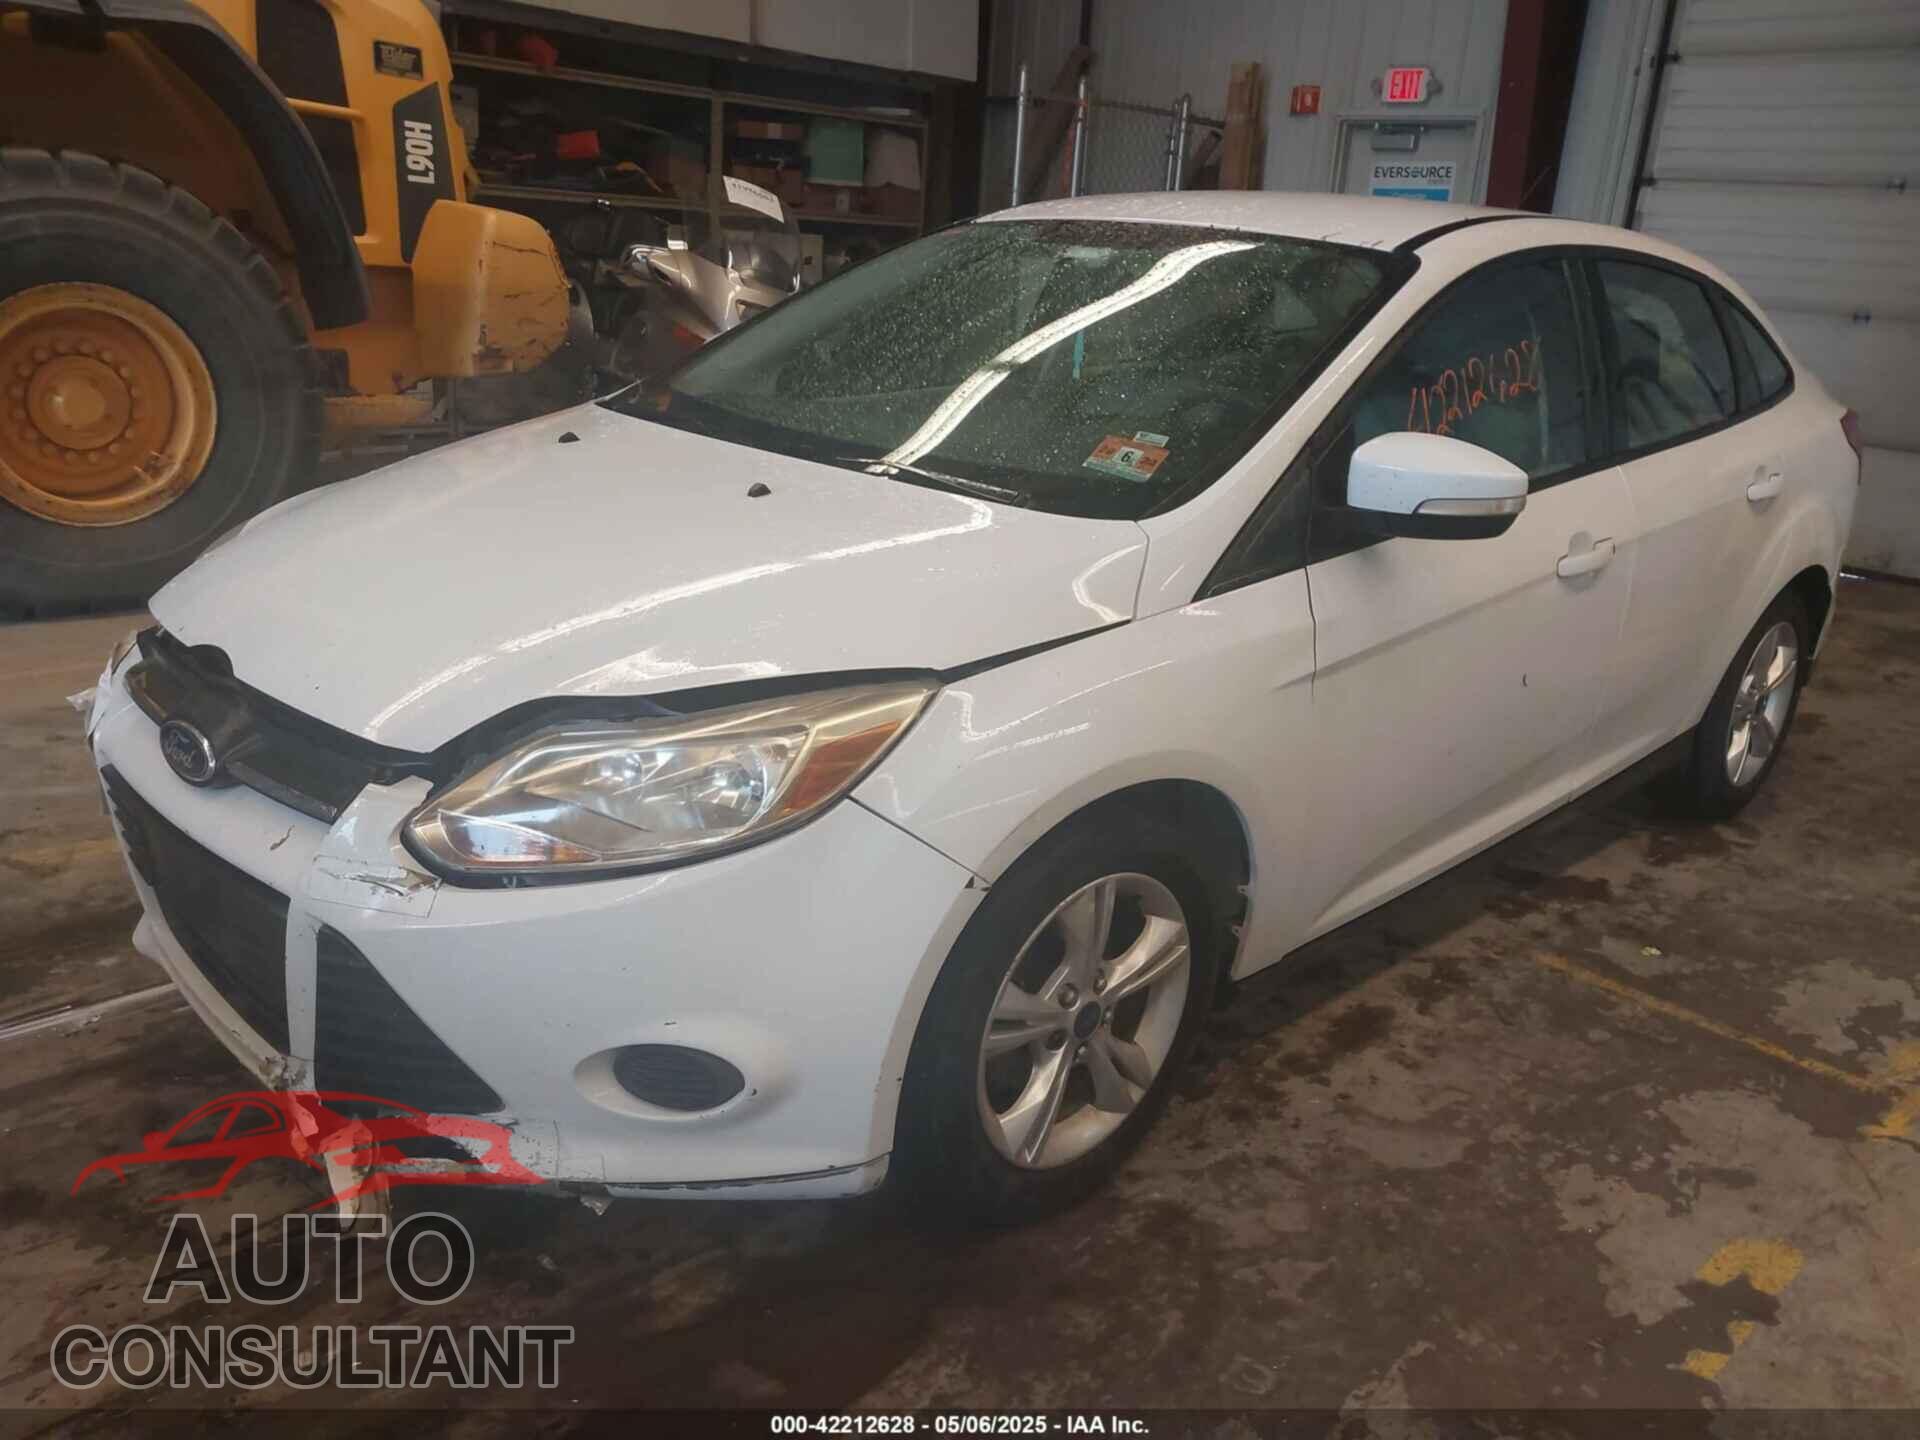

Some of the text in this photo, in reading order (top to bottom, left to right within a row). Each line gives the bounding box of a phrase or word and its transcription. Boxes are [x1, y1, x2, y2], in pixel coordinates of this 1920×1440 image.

[1390, 70, 1425, 99] EXIT
[403, 120, 435, 184] L90H
[1374, 165, 1454, 178] EVERSOURCE
